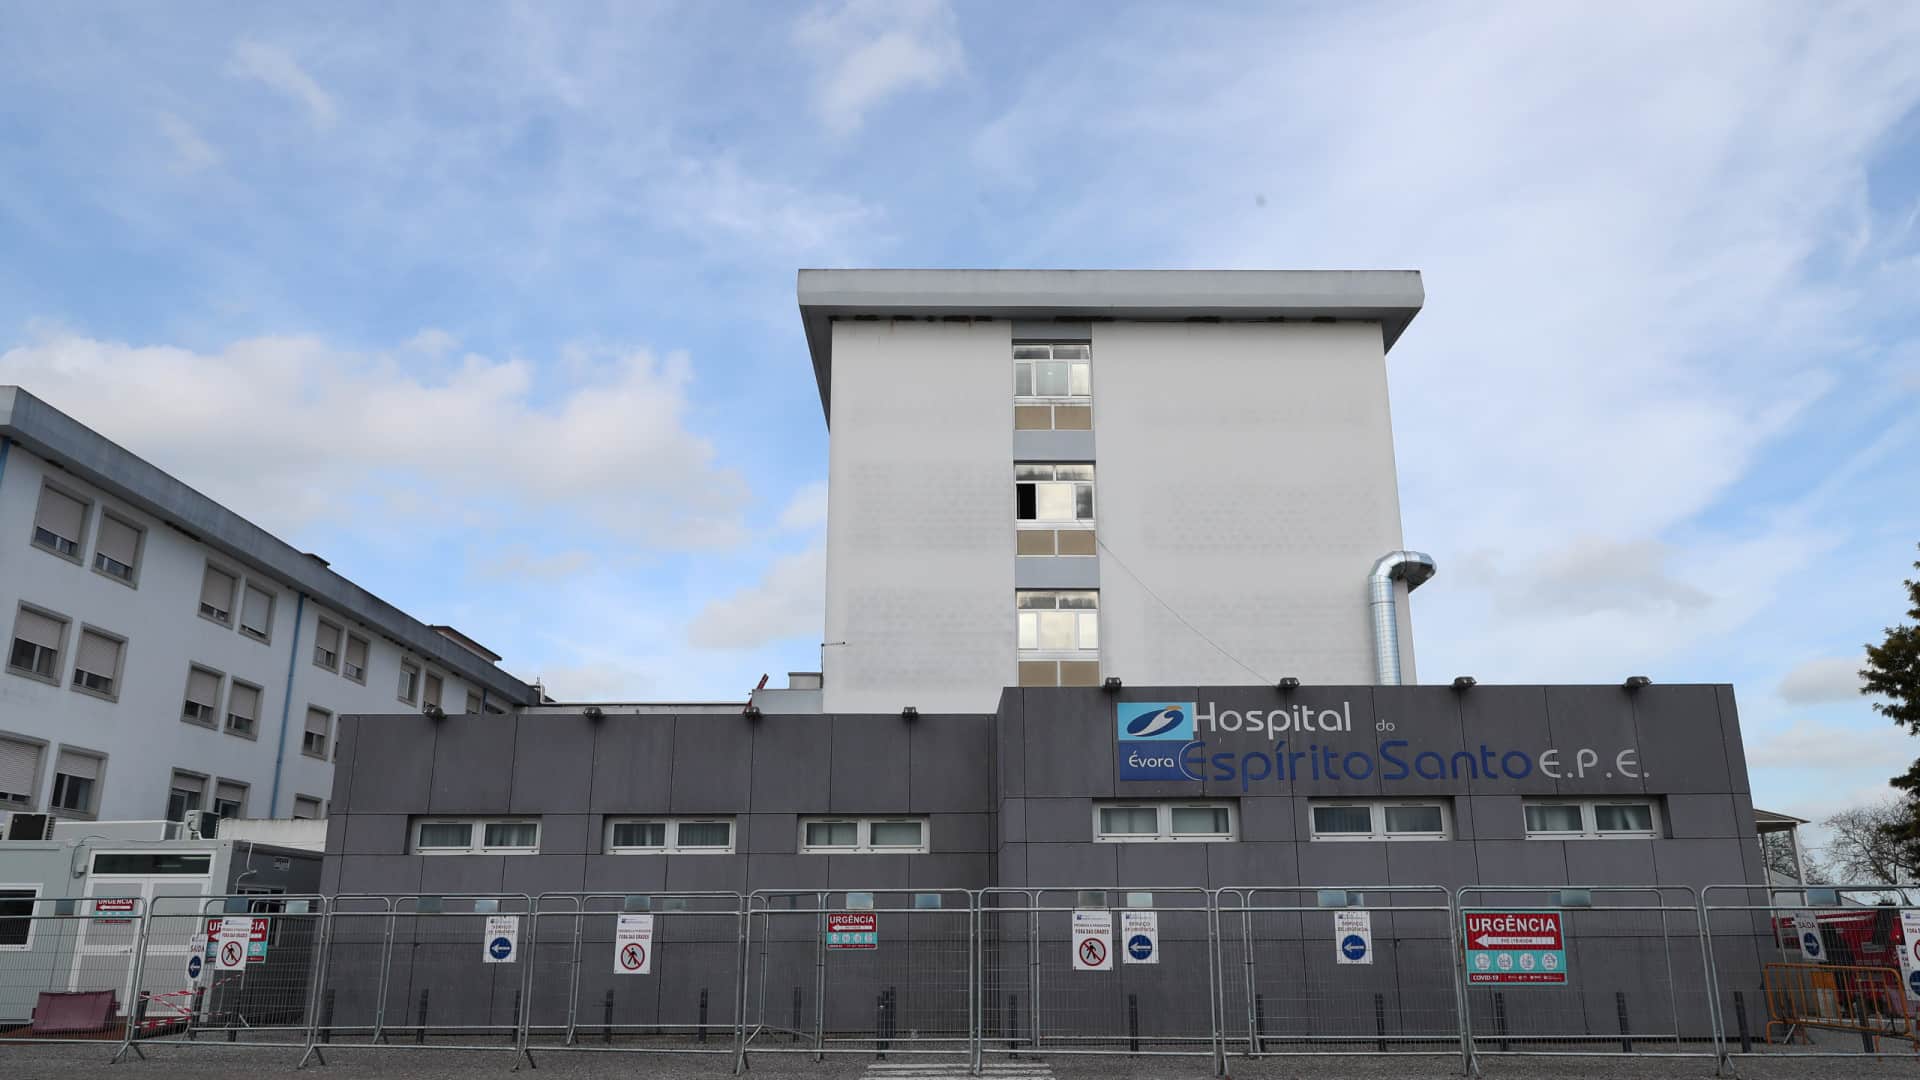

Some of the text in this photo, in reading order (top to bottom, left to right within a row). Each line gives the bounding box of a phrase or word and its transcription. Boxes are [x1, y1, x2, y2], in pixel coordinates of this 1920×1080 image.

[1193, 701, 1395, 740] Hospital do
[1129, 751, 1174, 768] Évora
[829, 914, 874, 924] URGÊNCIA
[1469, 915, 1557, 932] URGÊNCIA
